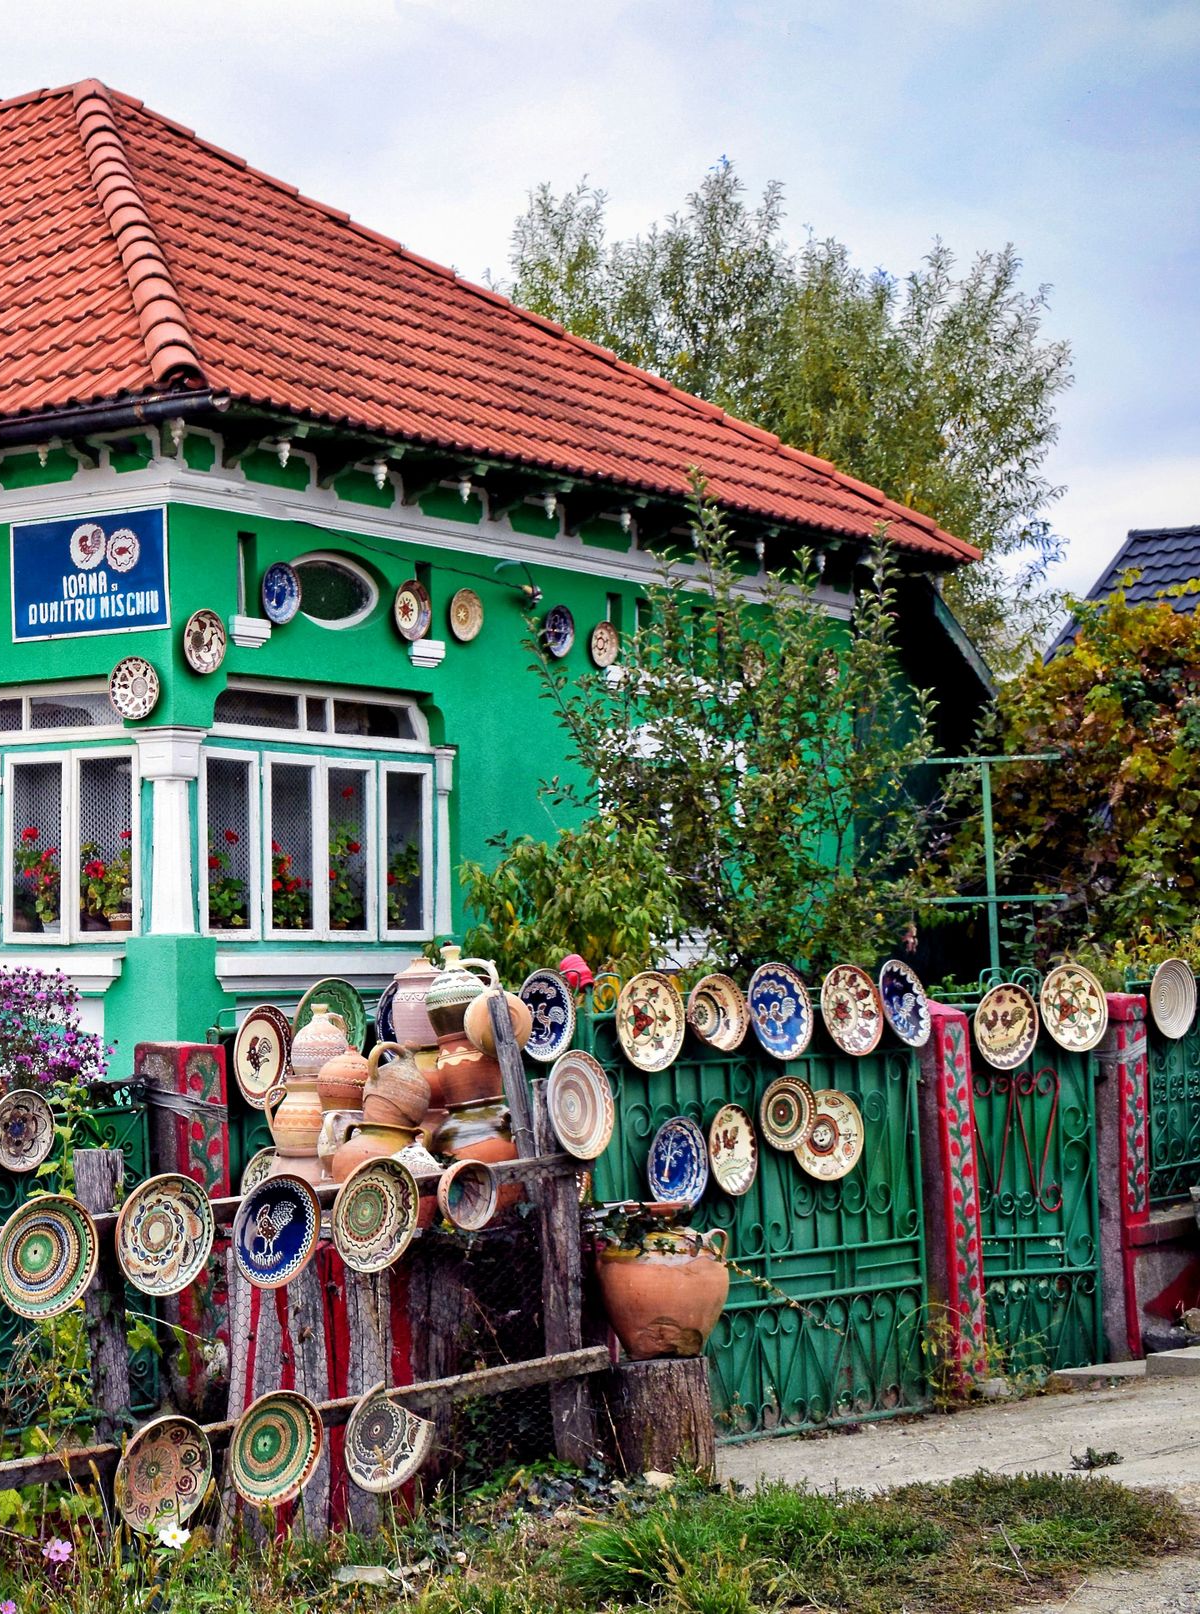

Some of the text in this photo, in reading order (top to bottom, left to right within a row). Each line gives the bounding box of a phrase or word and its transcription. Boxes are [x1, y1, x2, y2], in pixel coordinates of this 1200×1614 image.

[63, 571, 107, 599] IOANA
[28, 590, 159, 625] DUMITRU MISCHIU
